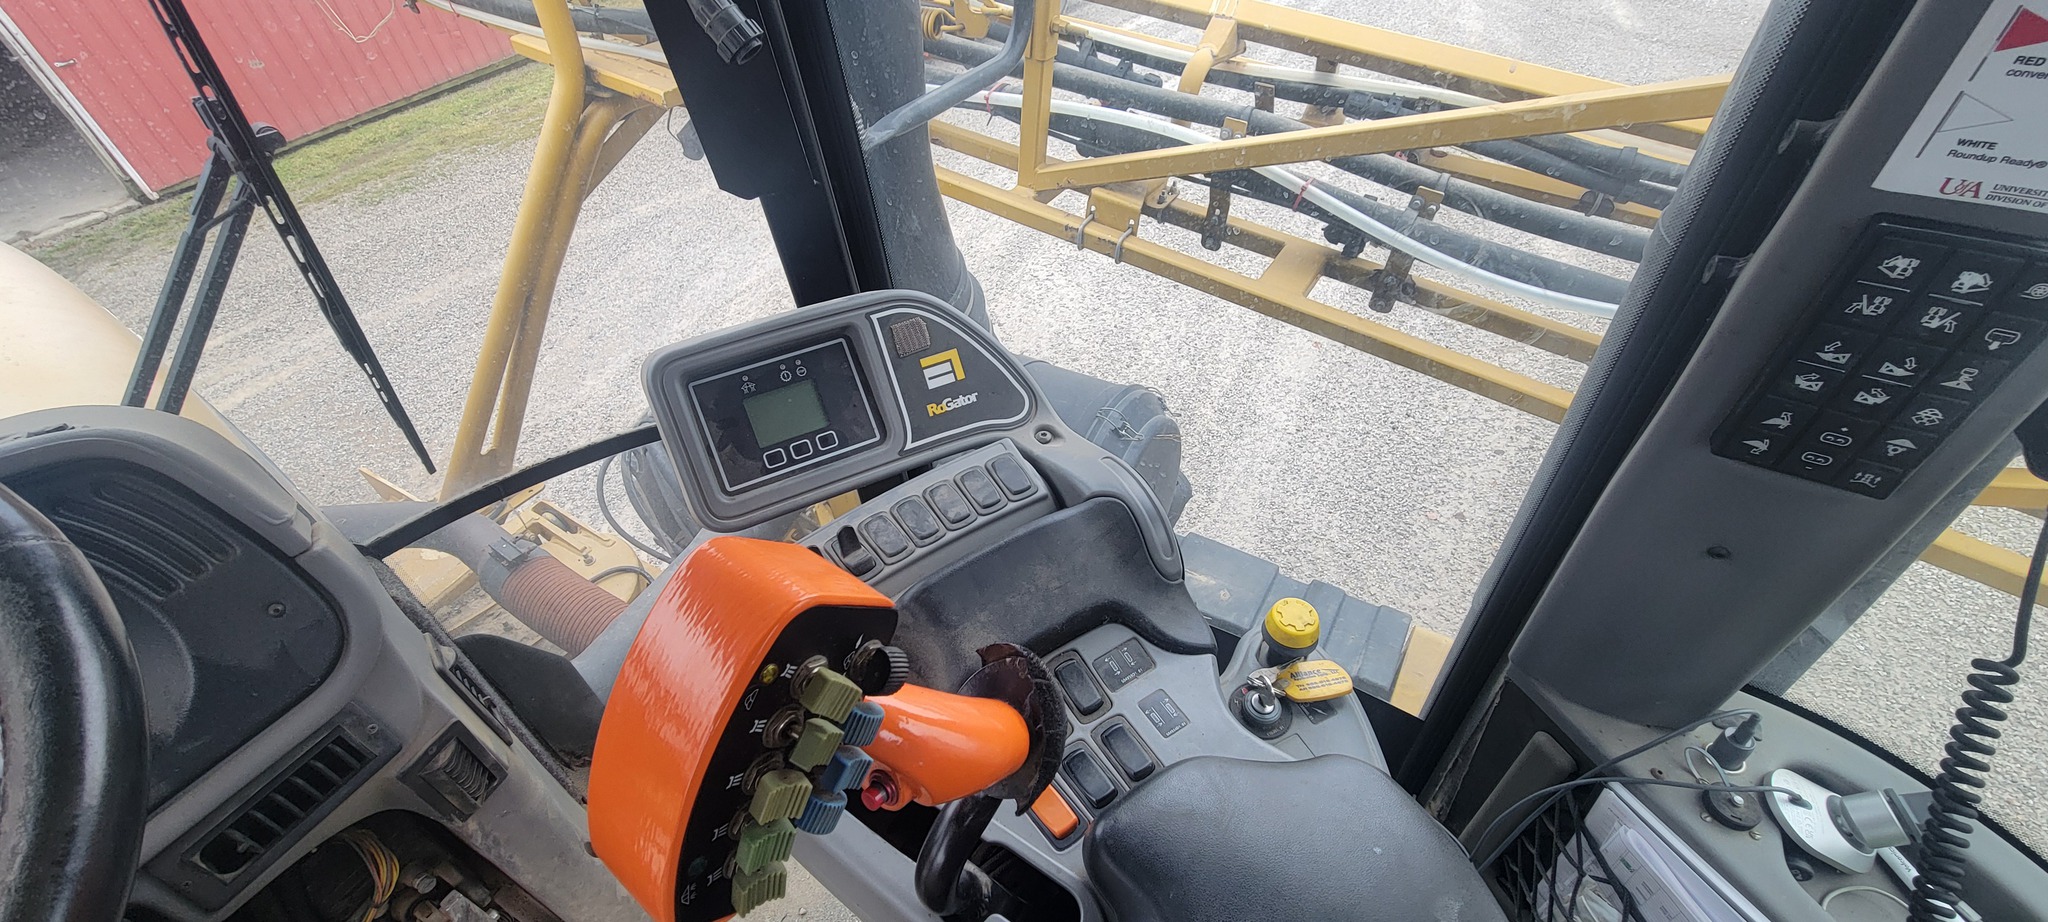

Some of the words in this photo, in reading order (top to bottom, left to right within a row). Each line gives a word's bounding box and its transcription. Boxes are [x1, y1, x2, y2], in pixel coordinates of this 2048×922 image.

[2013, 56, 2048, 67] RED
[1957, 138, 1998, 151] WHITE
[1947, 149, 1998, 164] Roundup
[1984, 194, 2033, 207] DIVISION
[2032, 200, 2048, 209] OF
[926, 392, 979, 417] RoGator
[1290, 669, 1322, 680] Alliance
